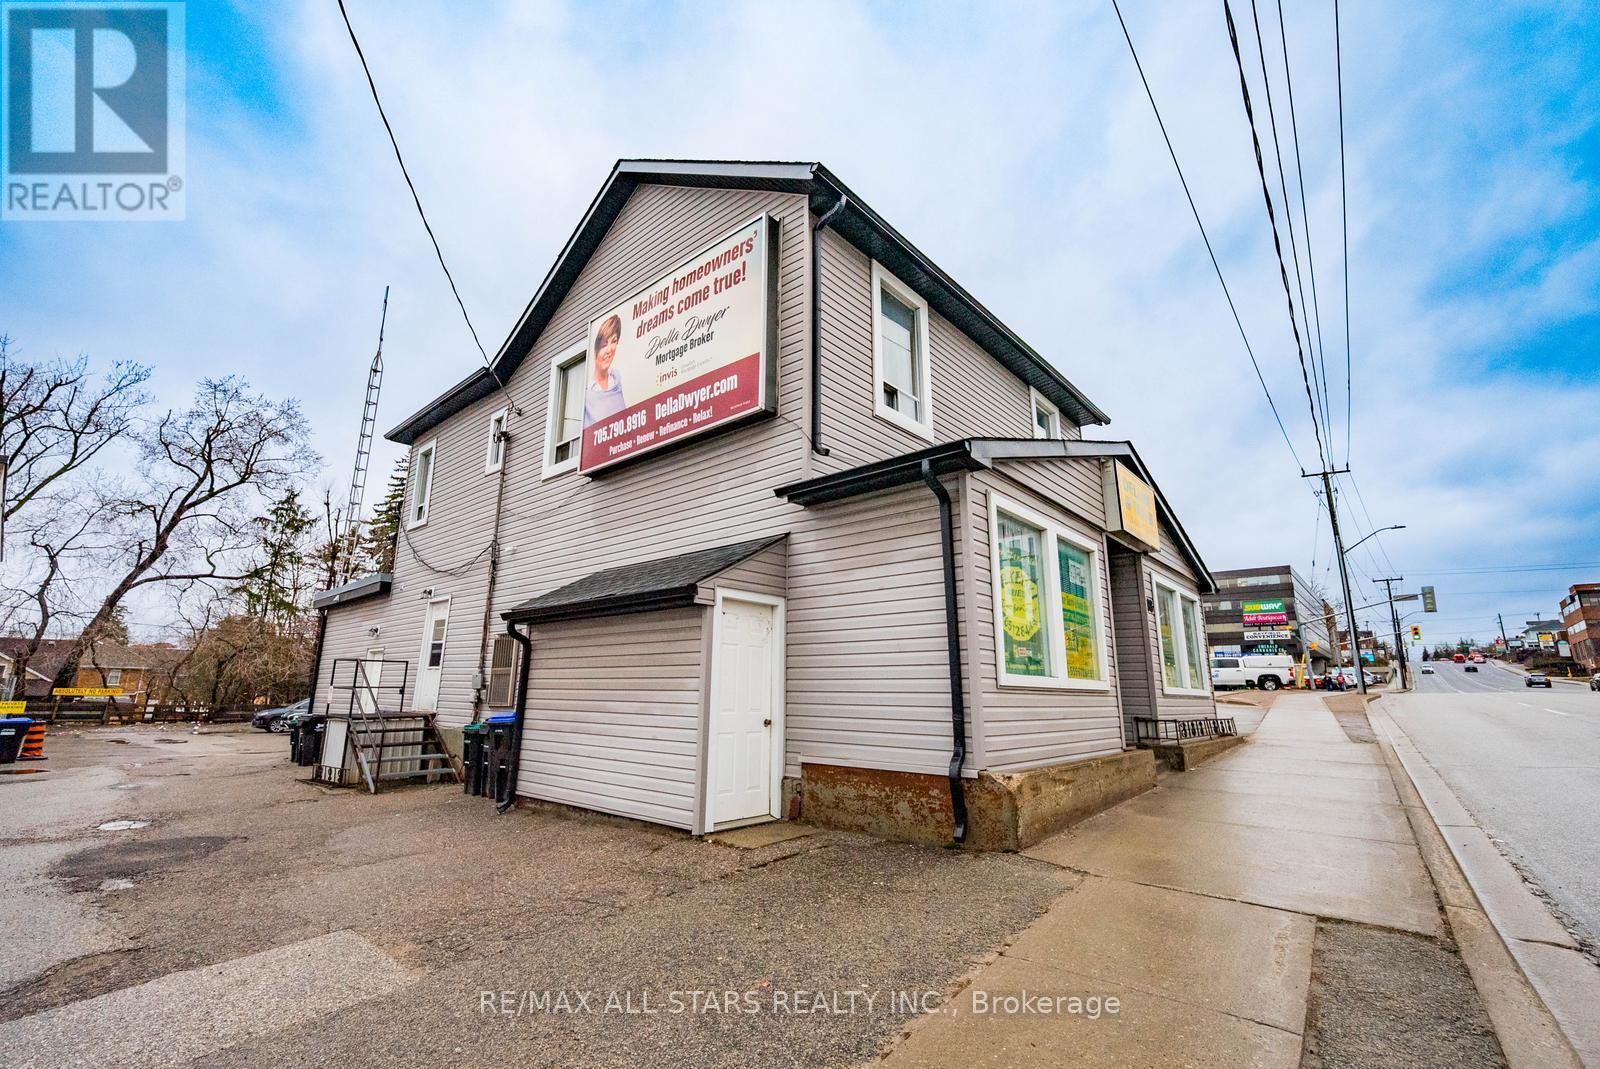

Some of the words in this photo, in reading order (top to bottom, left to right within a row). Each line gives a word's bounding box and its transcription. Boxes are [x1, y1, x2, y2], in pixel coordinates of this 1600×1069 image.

[632, 286, 669, 321] Making
[636, 304, 675, 339] dreams
[677, 285, 710, 315] come
[713, 260, 747, 295] true!
[644, 327, 680, 360] Della
[681, 305, 731, 341] Dwyer
[655, 343, 688, 367] Mortgage
[689, 331, 715, 351] Broker
[659, 366, 678, 383] invis
[593, 409, 647, 447] 705.790.8916
[655, 374, 738, 421] DellaDwyer.com
[609, 439, 633, 456] Purchase
[636, 430, 655, 445] Renew
[659, 417, 688, 437] Refinance
[692, 405, 713, 424] Relax!
[1244, 602, 1282, 611] SUBWAY
